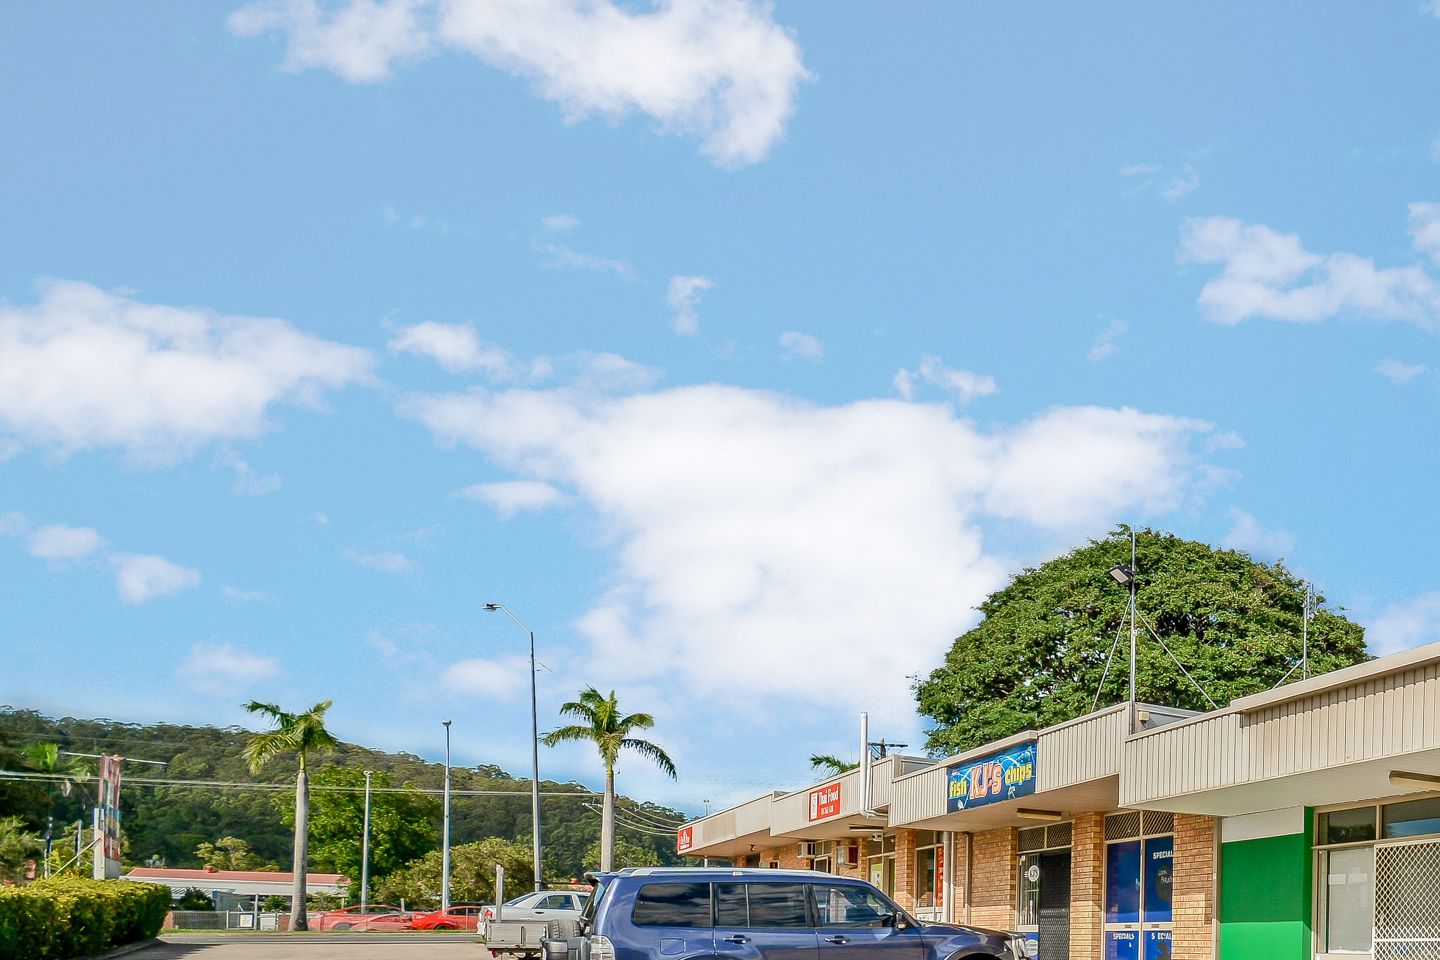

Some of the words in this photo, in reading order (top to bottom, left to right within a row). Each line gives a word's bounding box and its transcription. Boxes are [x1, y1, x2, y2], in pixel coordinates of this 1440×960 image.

[949, 779, 968, 799] fish
[1005, 762, 1033, 786] chips
[828, 786, 839, 803] Food
